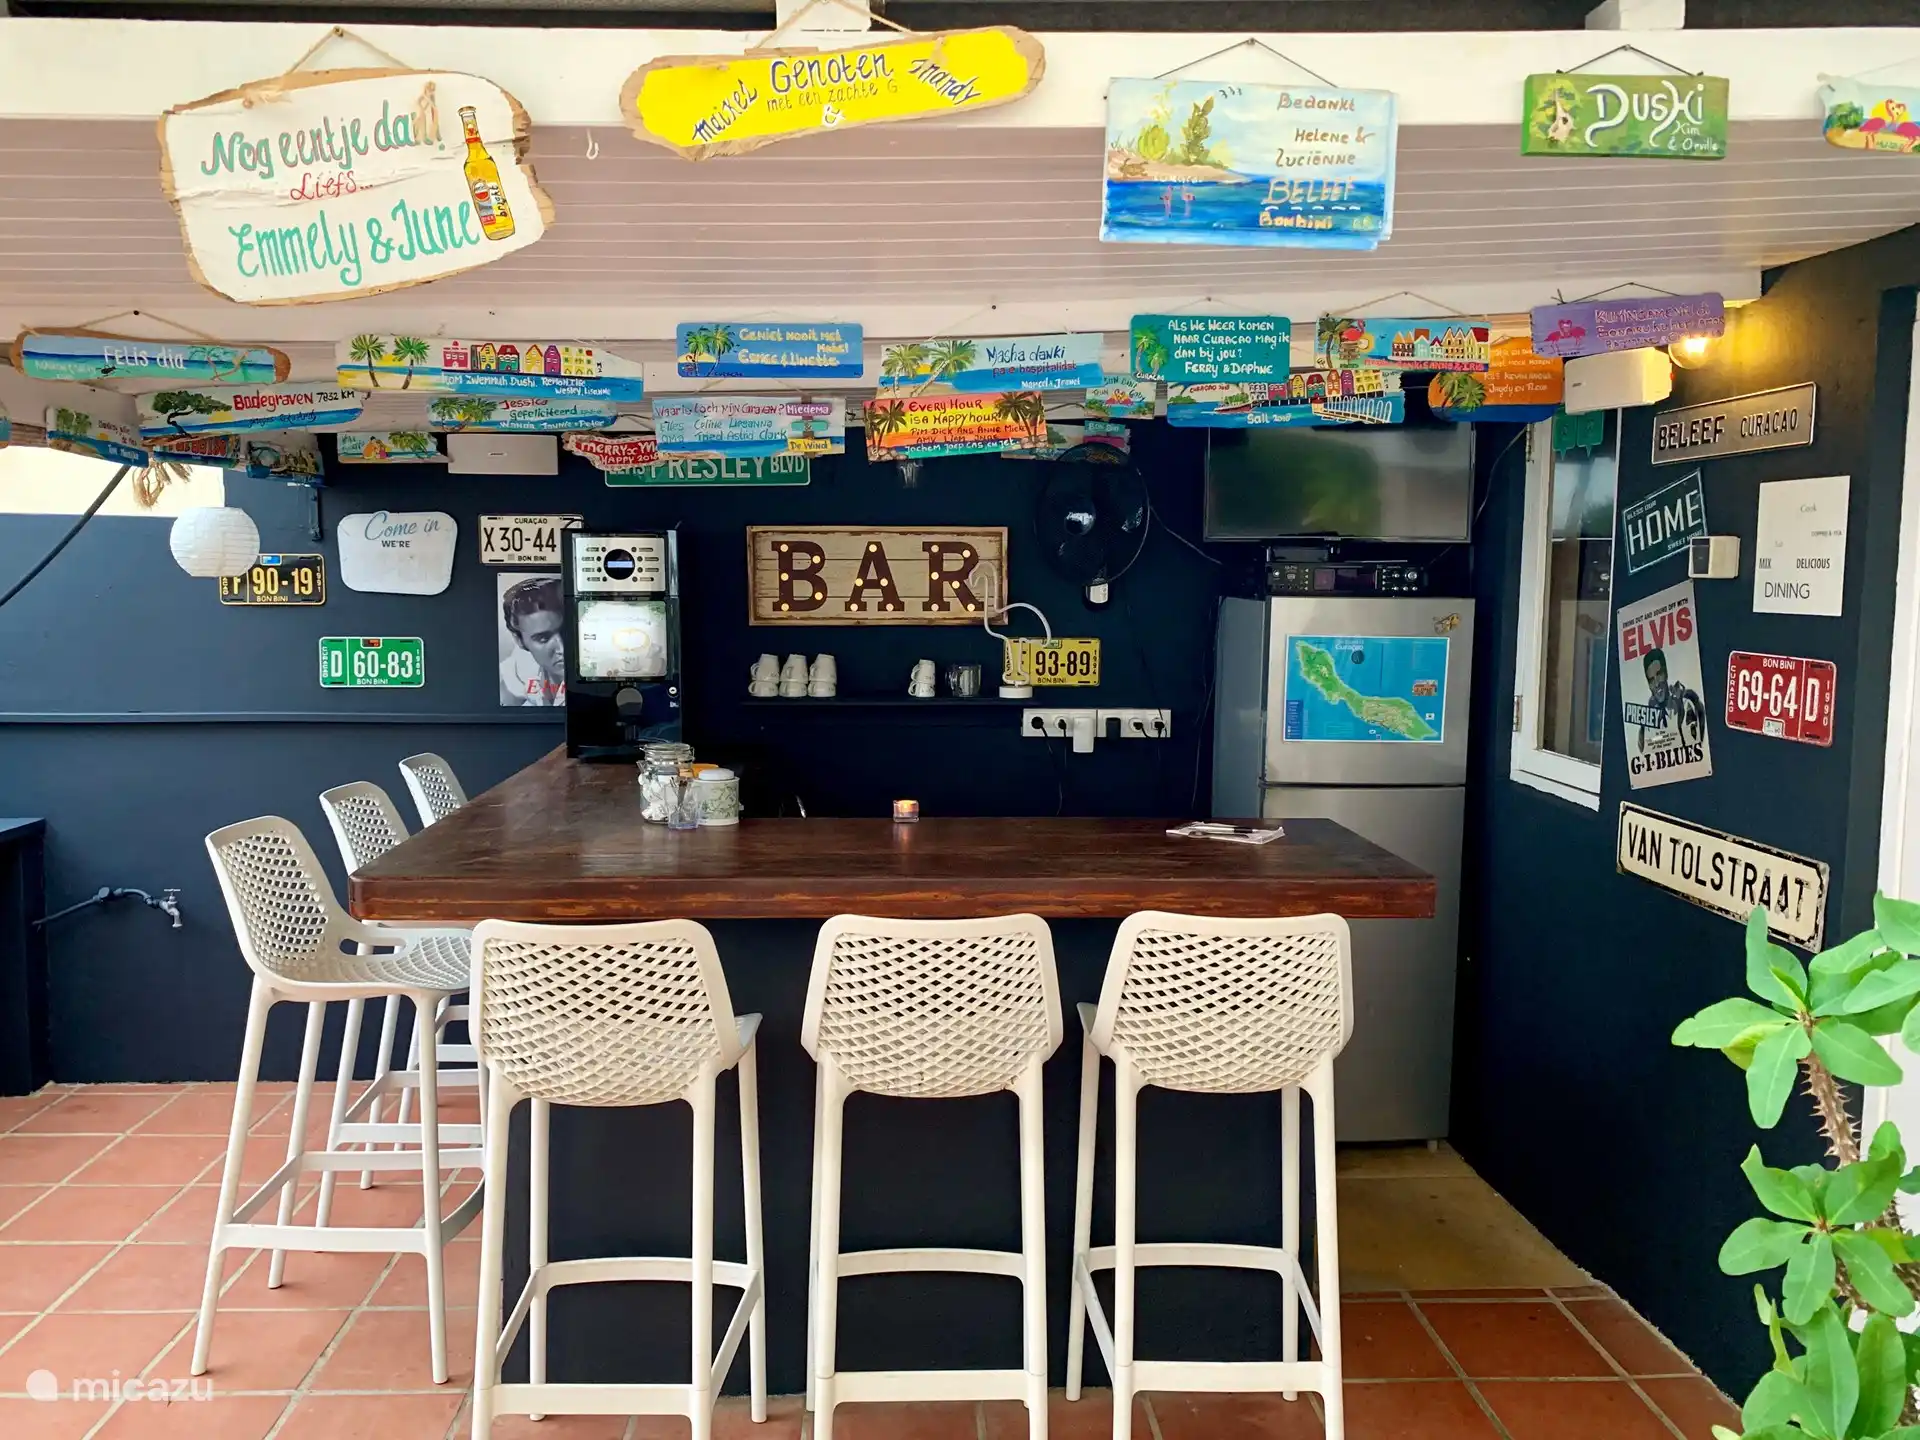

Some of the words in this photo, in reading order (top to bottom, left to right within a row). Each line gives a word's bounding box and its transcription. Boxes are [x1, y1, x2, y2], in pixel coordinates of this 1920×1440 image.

[771, 52, 893, 94] Genoten
[767, 94, 793, 113] met
[799, 90, 822, 107] een
[828, 81, 879, 103] zachte
[201, 131, 274, 180] Nog
[279, 114, 369, 171] eentje
[1354, 126, 1376, 145] &
[228, 209, 362, 288] Emmely
[392, 197, 481, 262] June
[1173, 333, 1200, 345] NAAR
[156, 345, 187, 370] dia
[1657, 413, 1728, 451] BELEEF
[769, 453, 806, 474] BLVD
[364, 511, 418, 541] Come
[423, 518, 440, 533] in
[1627, 489, 1702, 556] HOME
[483, 527, 495, 553] X
[499, 527, 557, 553] 30-44
[770, 540, 984, 613] BAR
[1796, 558, 1831, 569] DELICIOUS
[252, 566, 314, 595] 90-19
[1764, 581, 1811, 600] DINING
[1621, 606, 1694, 662] ELVIS
[330, 650, 343, 678] D
[353, 650, 413, 679] 60-83
[1035, 650, 1091, 677] 93-89
[1762, 657, 1779, 668] BON
[1779, 660, 1796, 670] BINI
[1737, 668, 1798, 719] 69-64
[1804, 677, 1820, 722] D
[1626, 704, 1661, 728] PRESLEY
[1627, 821, 1663, 870] VAN
[1669, 836, 1809, 923] TOLSTRAAT
